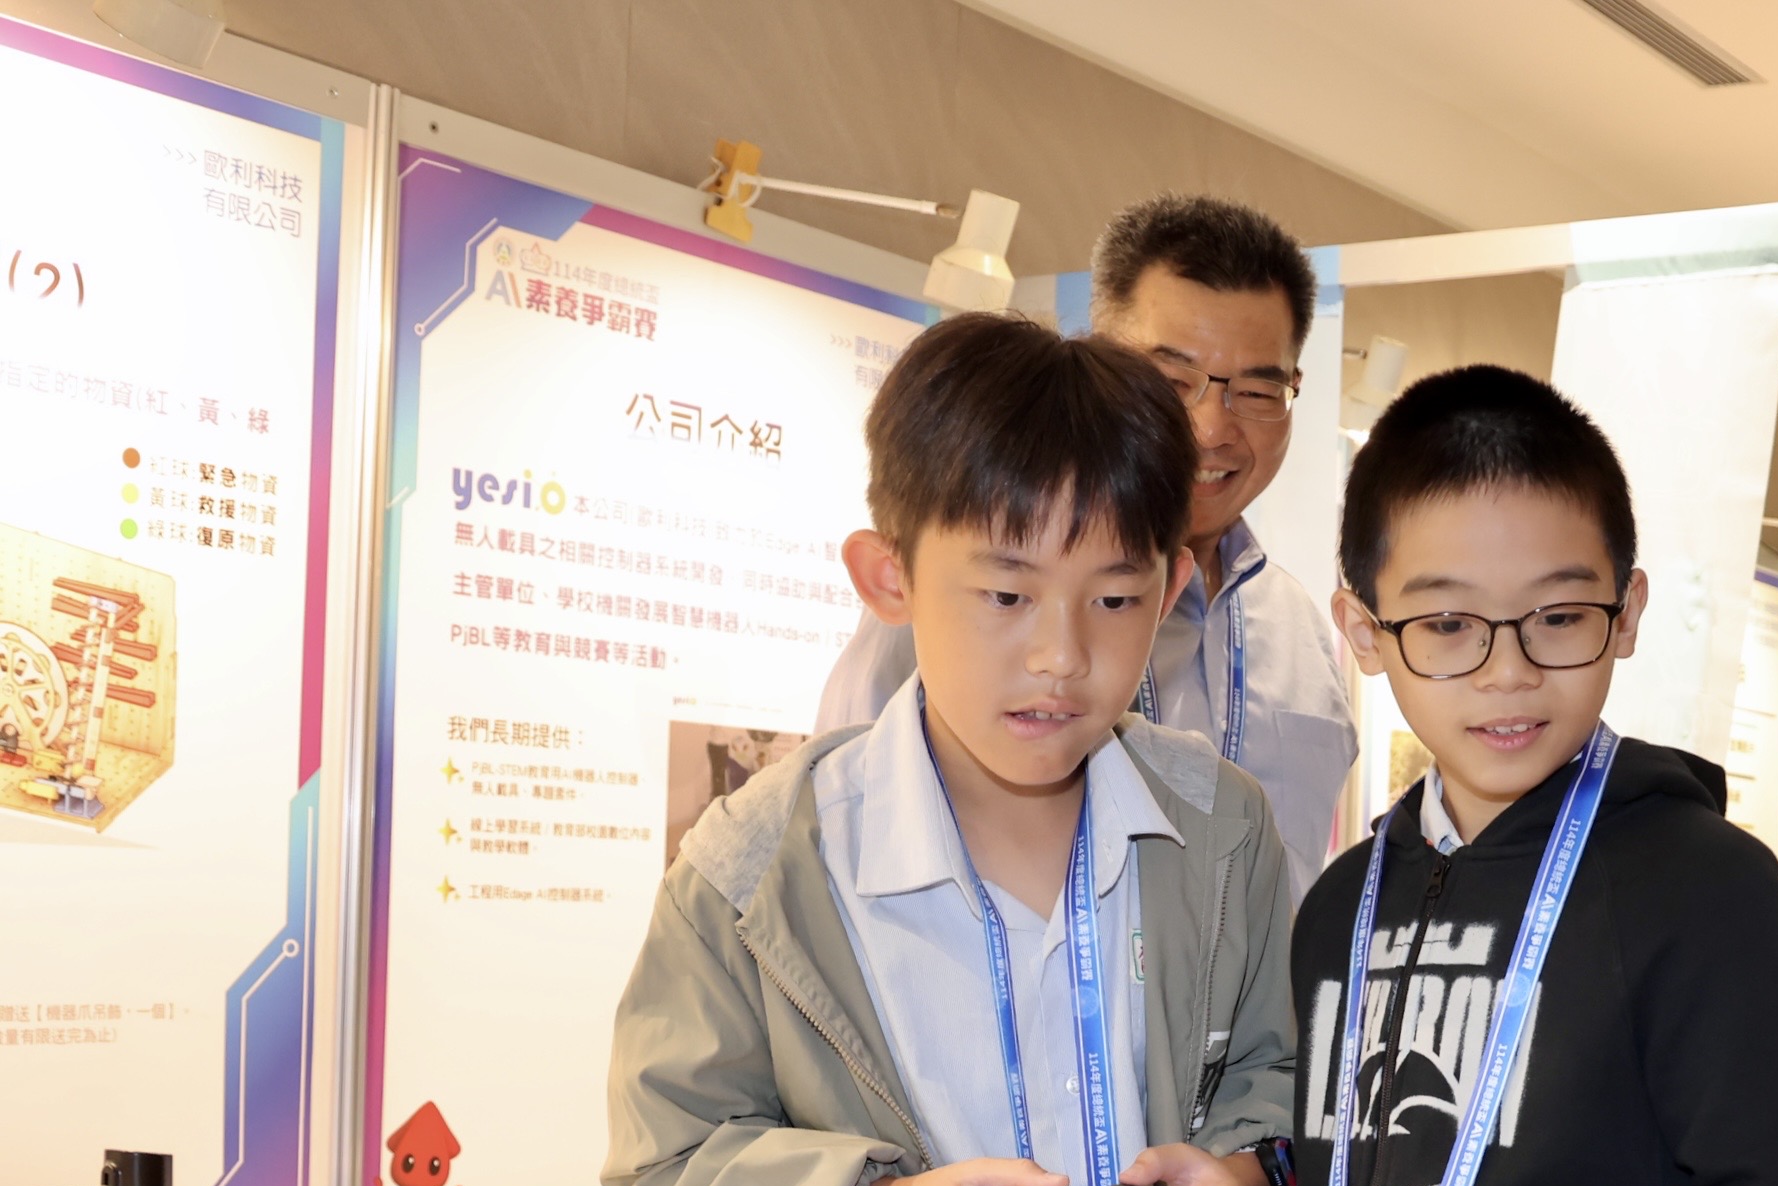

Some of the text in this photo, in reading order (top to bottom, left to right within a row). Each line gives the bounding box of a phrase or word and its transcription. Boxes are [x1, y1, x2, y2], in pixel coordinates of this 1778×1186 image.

[202, 148, 305, 204] 歐利科技
[202, 187, 303, 239] 有限公司
[624, 391, 783, 470] 公司介紹
